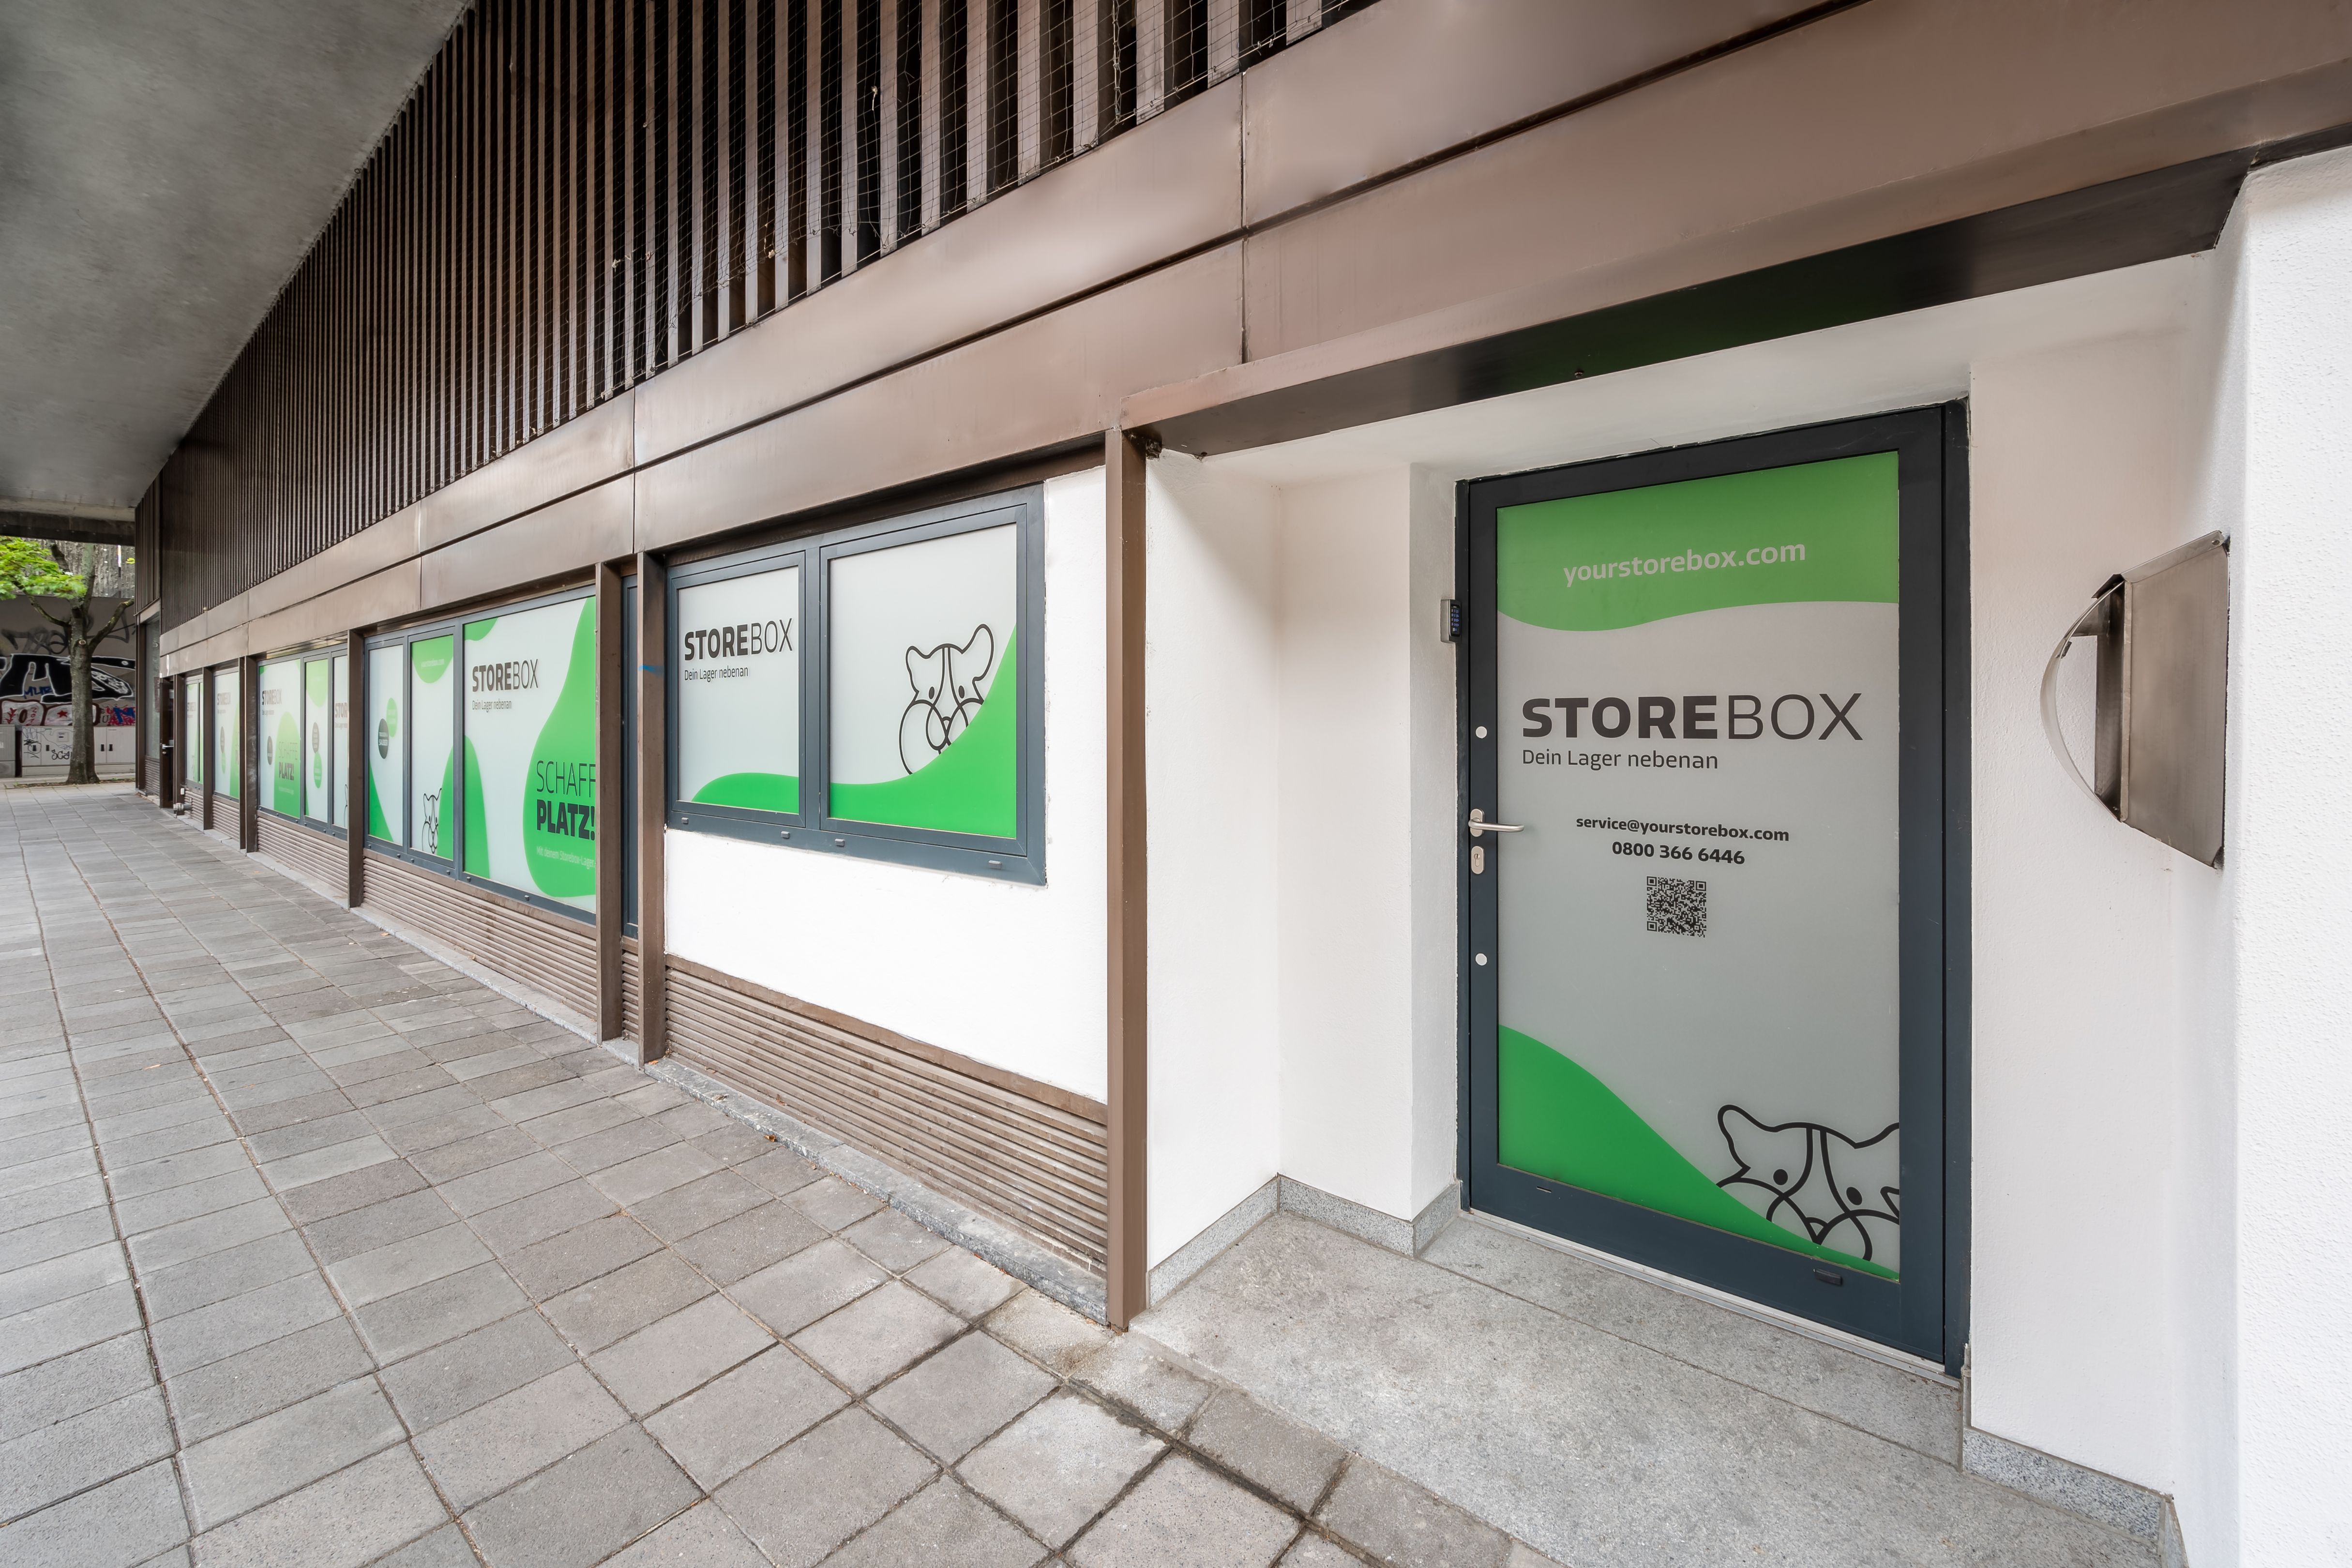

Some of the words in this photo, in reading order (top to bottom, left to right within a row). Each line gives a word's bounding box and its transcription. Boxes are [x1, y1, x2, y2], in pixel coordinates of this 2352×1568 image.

[1563, 543, 1806, 588] yourstorebox.com
[684, 618, 793, 661] STOREBOX
[472, 659, 538, 692] STOREBOX
[684, 668, 698, 681] Dein
[699, 668, 718, 683] Lager
[719, 665, 748, 678] nebenan
[472, 698, 481, 710] Dein
[481, 699, 493, 713] Lager
[493, 698, 512, 709] nebenan
[1522, 693, 1863, 741] STOREBOX
[1523, 748, 1562, 765] Dein
[1568, 750, 1622, 771] Lager
[1628, 750, 1718, 769] nebenan
[536, 760, 596, 798] SCHAFF
[537, 799, 595, 841] PLATZ!
[1576, 816, 1790, 842] service@yourstorebox.com
[1612, 841, 1655, 858] 0800
[1659, 844, 1693, 860] 366
[1698, 848, 1745, 865] 6446
